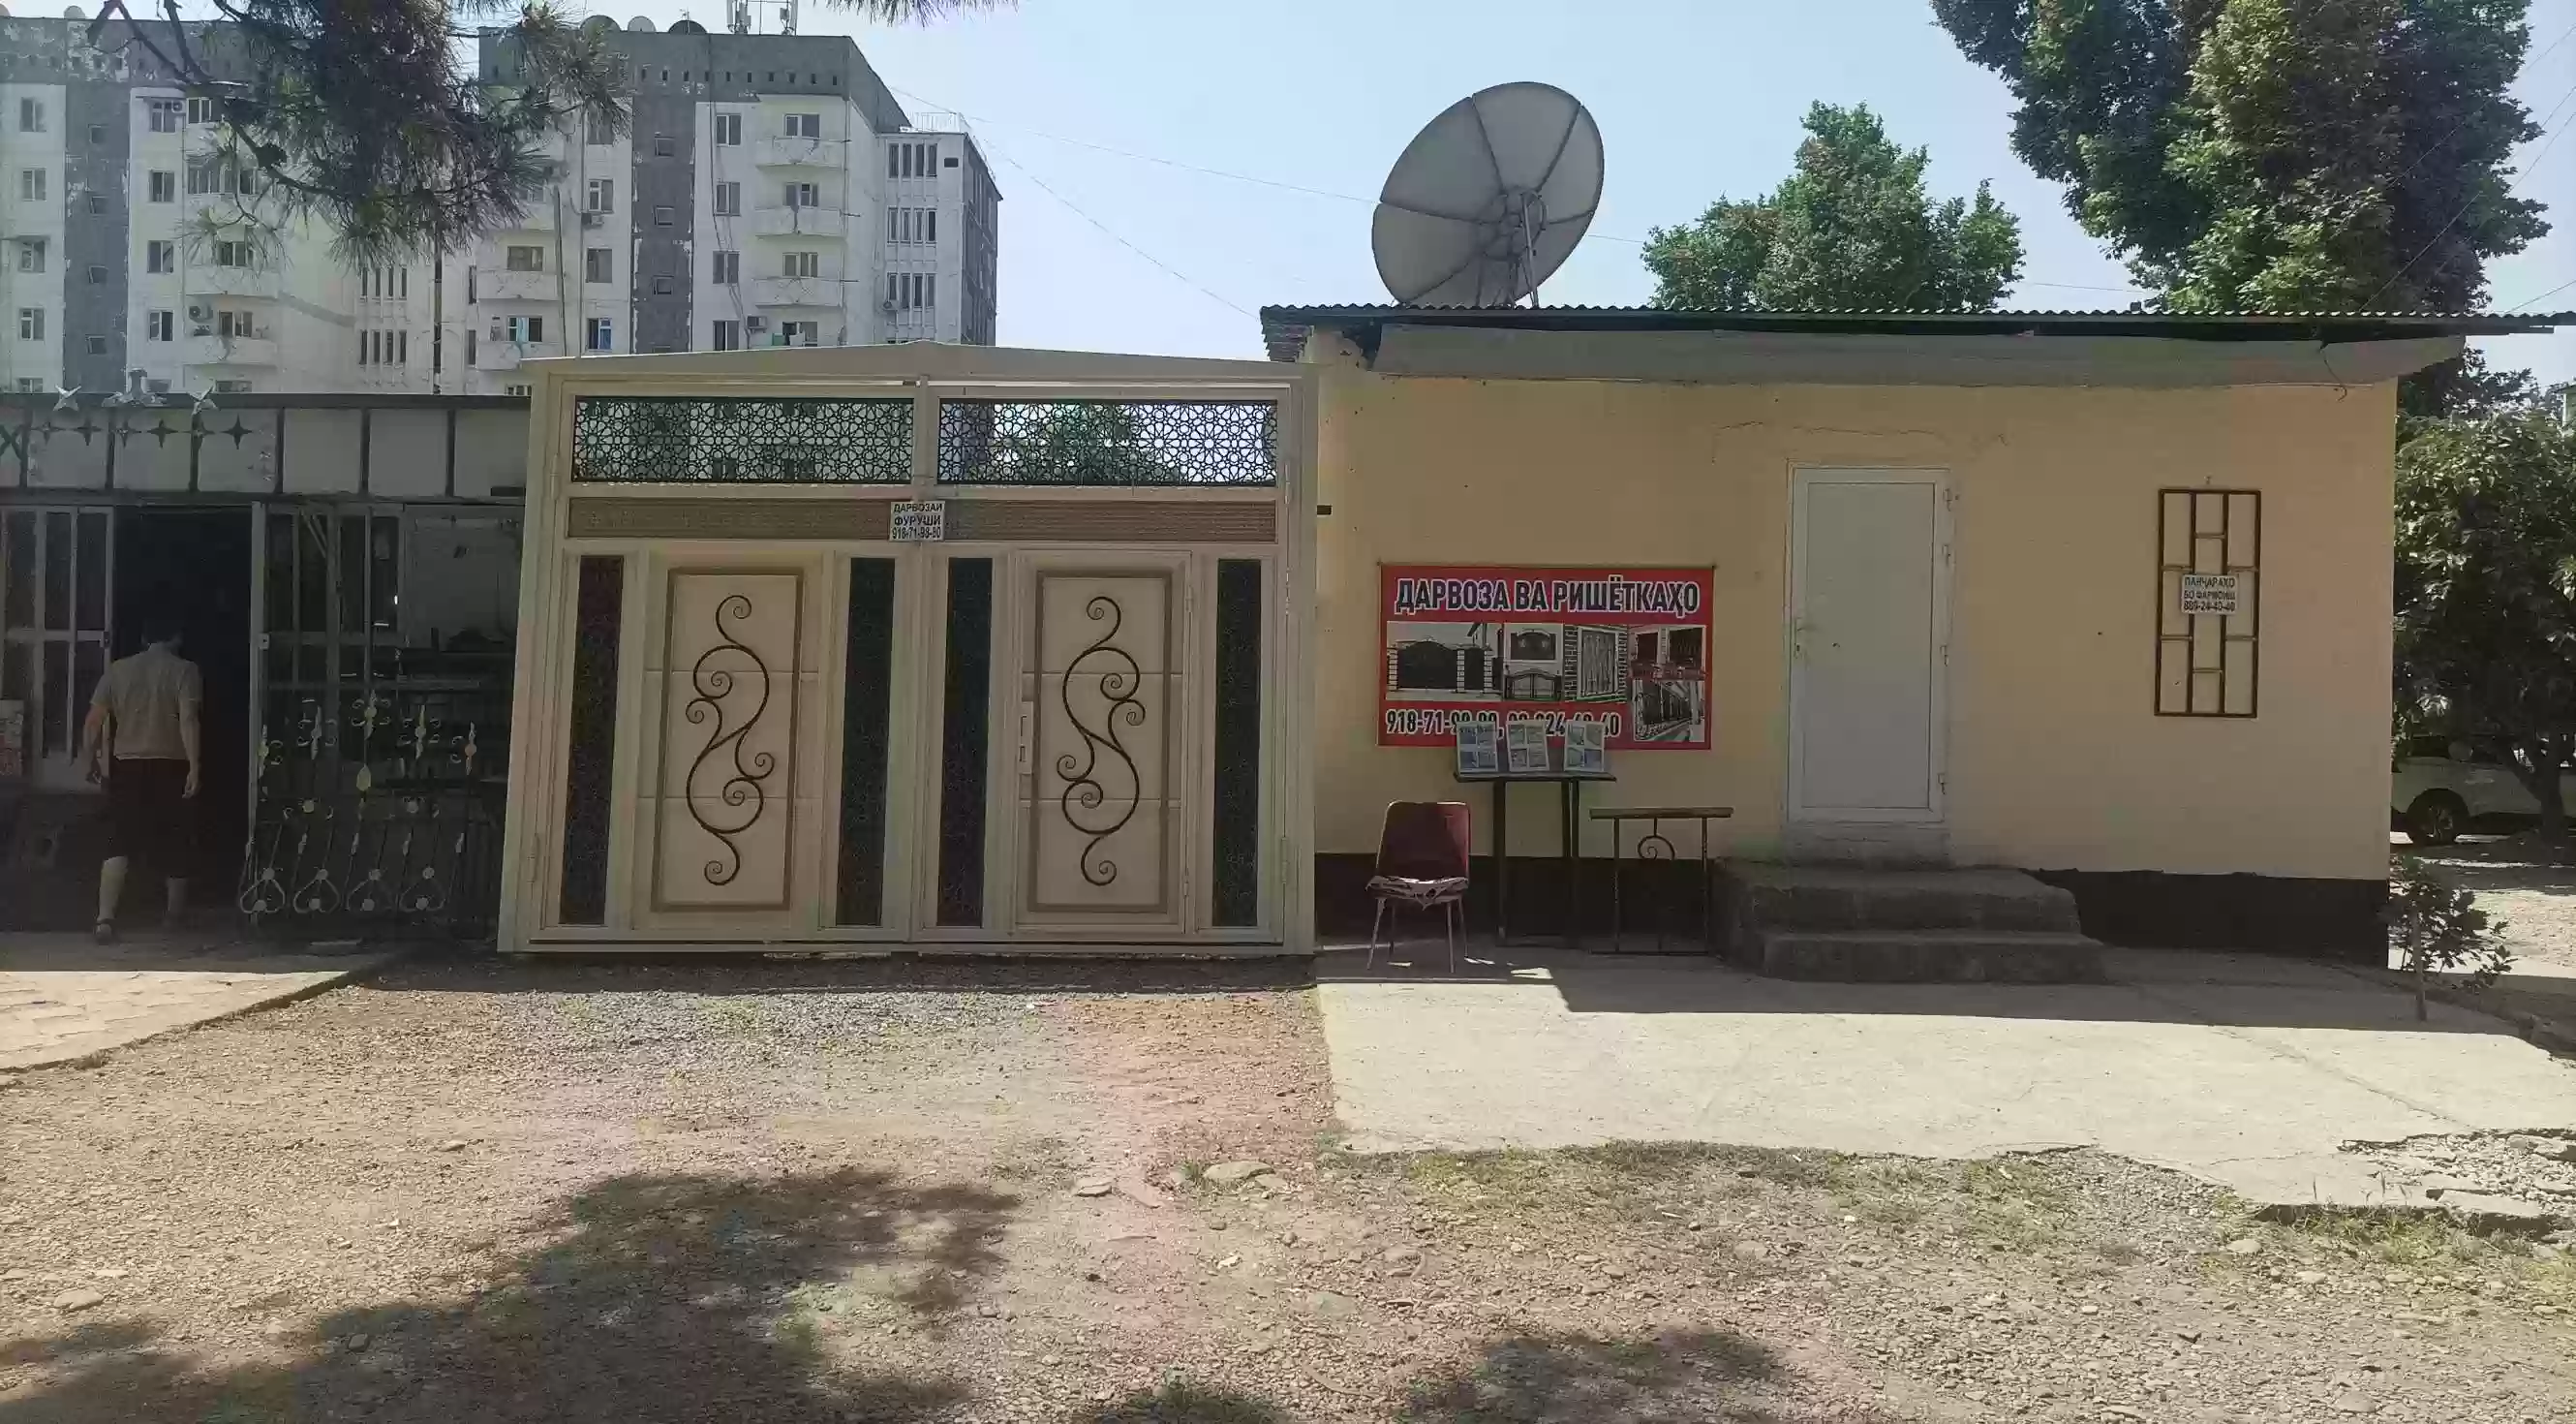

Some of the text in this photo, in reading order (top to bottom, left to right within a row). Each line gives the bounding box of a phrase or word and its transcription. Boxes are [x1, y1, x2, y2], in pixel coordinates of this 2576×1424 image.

[1395, 573, 1700, 618] ДАРВОЗА ВА РИШЁТКАҲО
